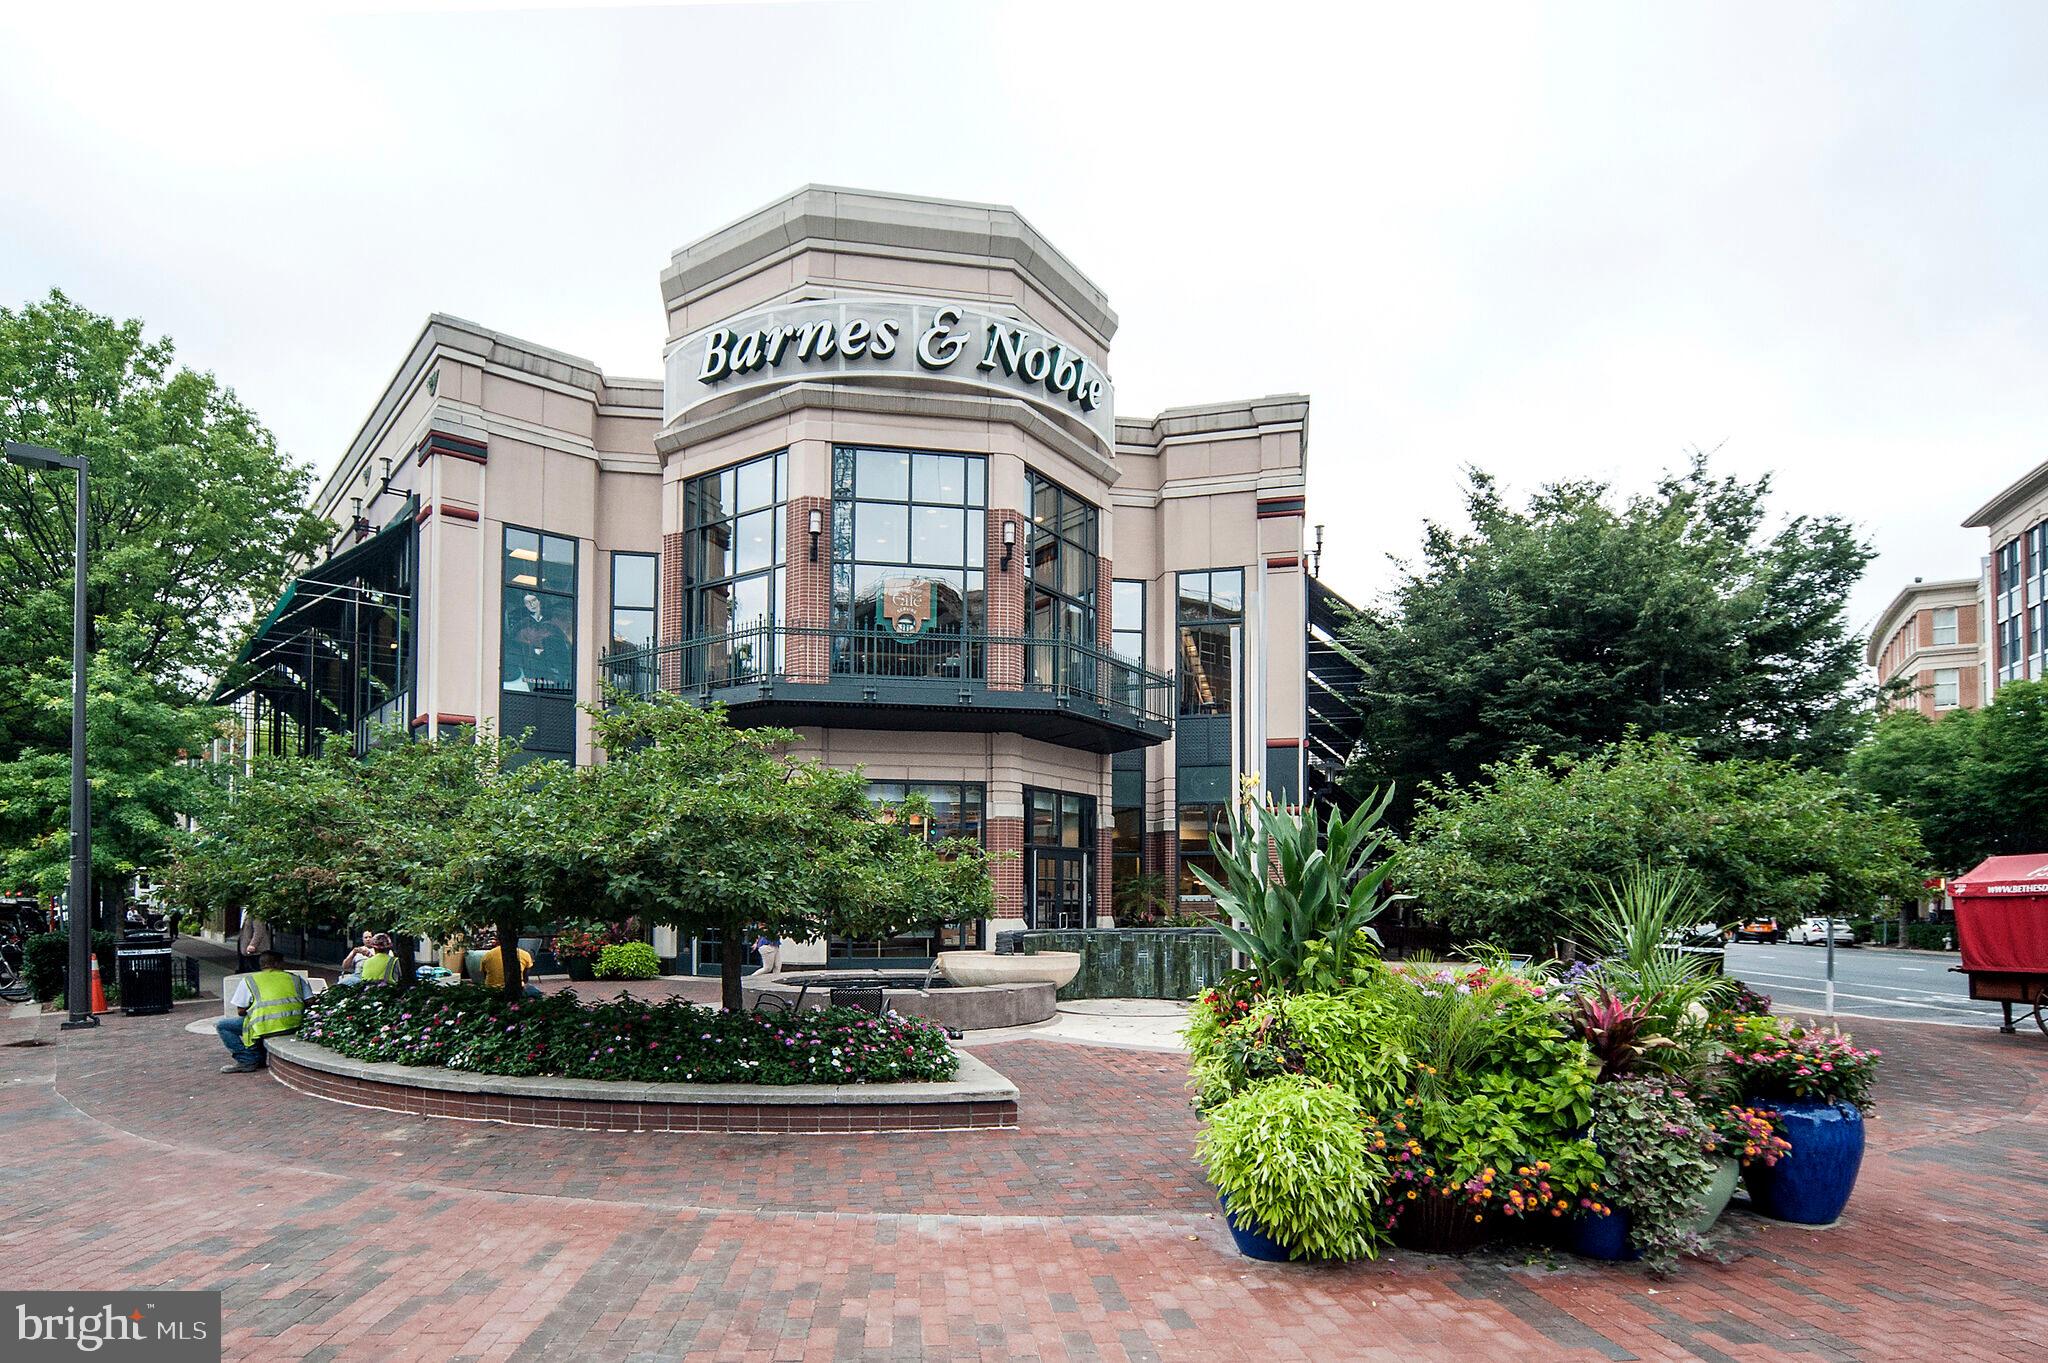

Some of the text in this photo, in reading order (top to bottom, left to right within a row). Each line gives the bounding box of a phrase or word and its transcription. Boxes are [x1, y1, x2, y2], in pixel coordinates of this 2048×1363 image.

[698, 304, 1104, 412] Barnes & Noble
